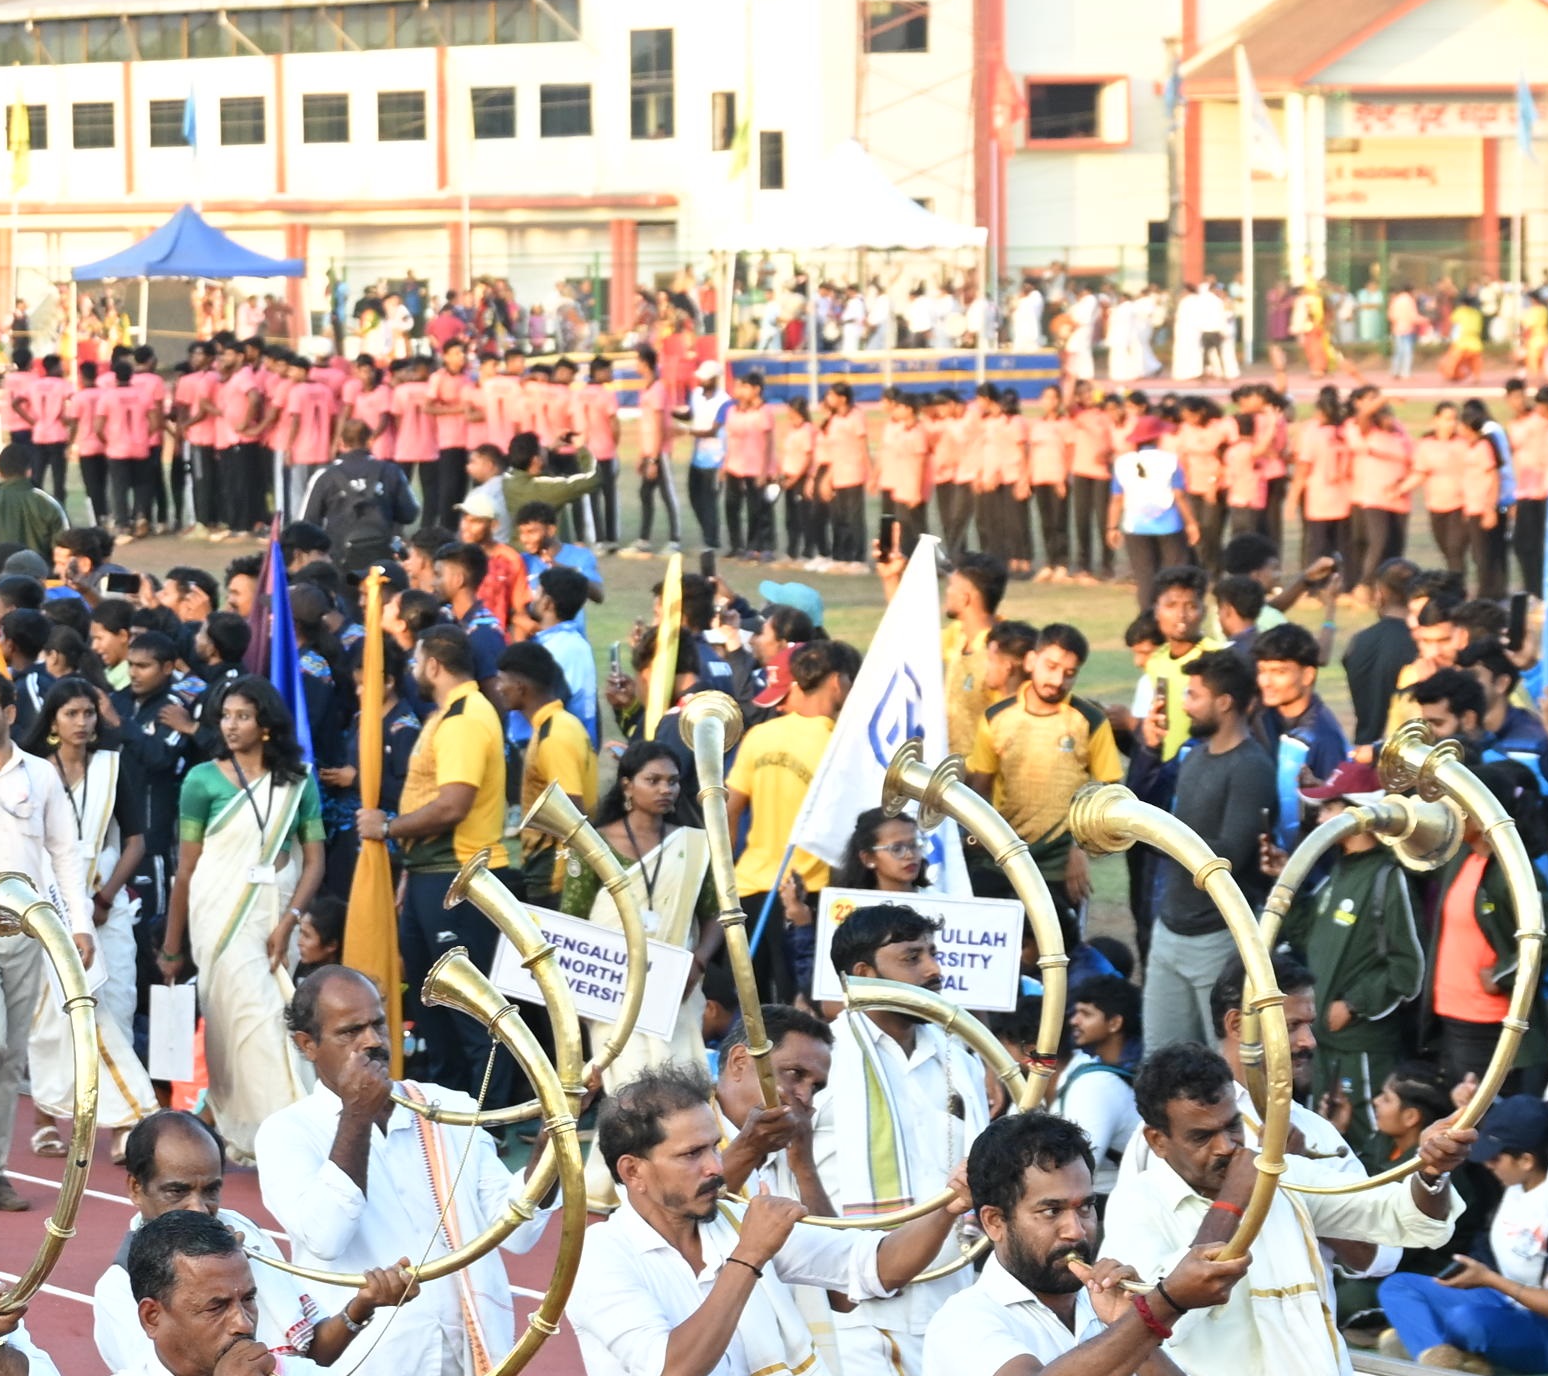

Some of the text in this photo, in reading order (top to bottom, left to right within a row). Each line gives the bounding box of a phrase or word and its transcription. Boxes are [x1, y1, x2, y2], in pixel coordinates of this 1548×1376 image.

[941, 929, 1007, 947] ULLAH
[934, 951, 992, 969] RSITY
[559, 955, 624, 984] NORTH
